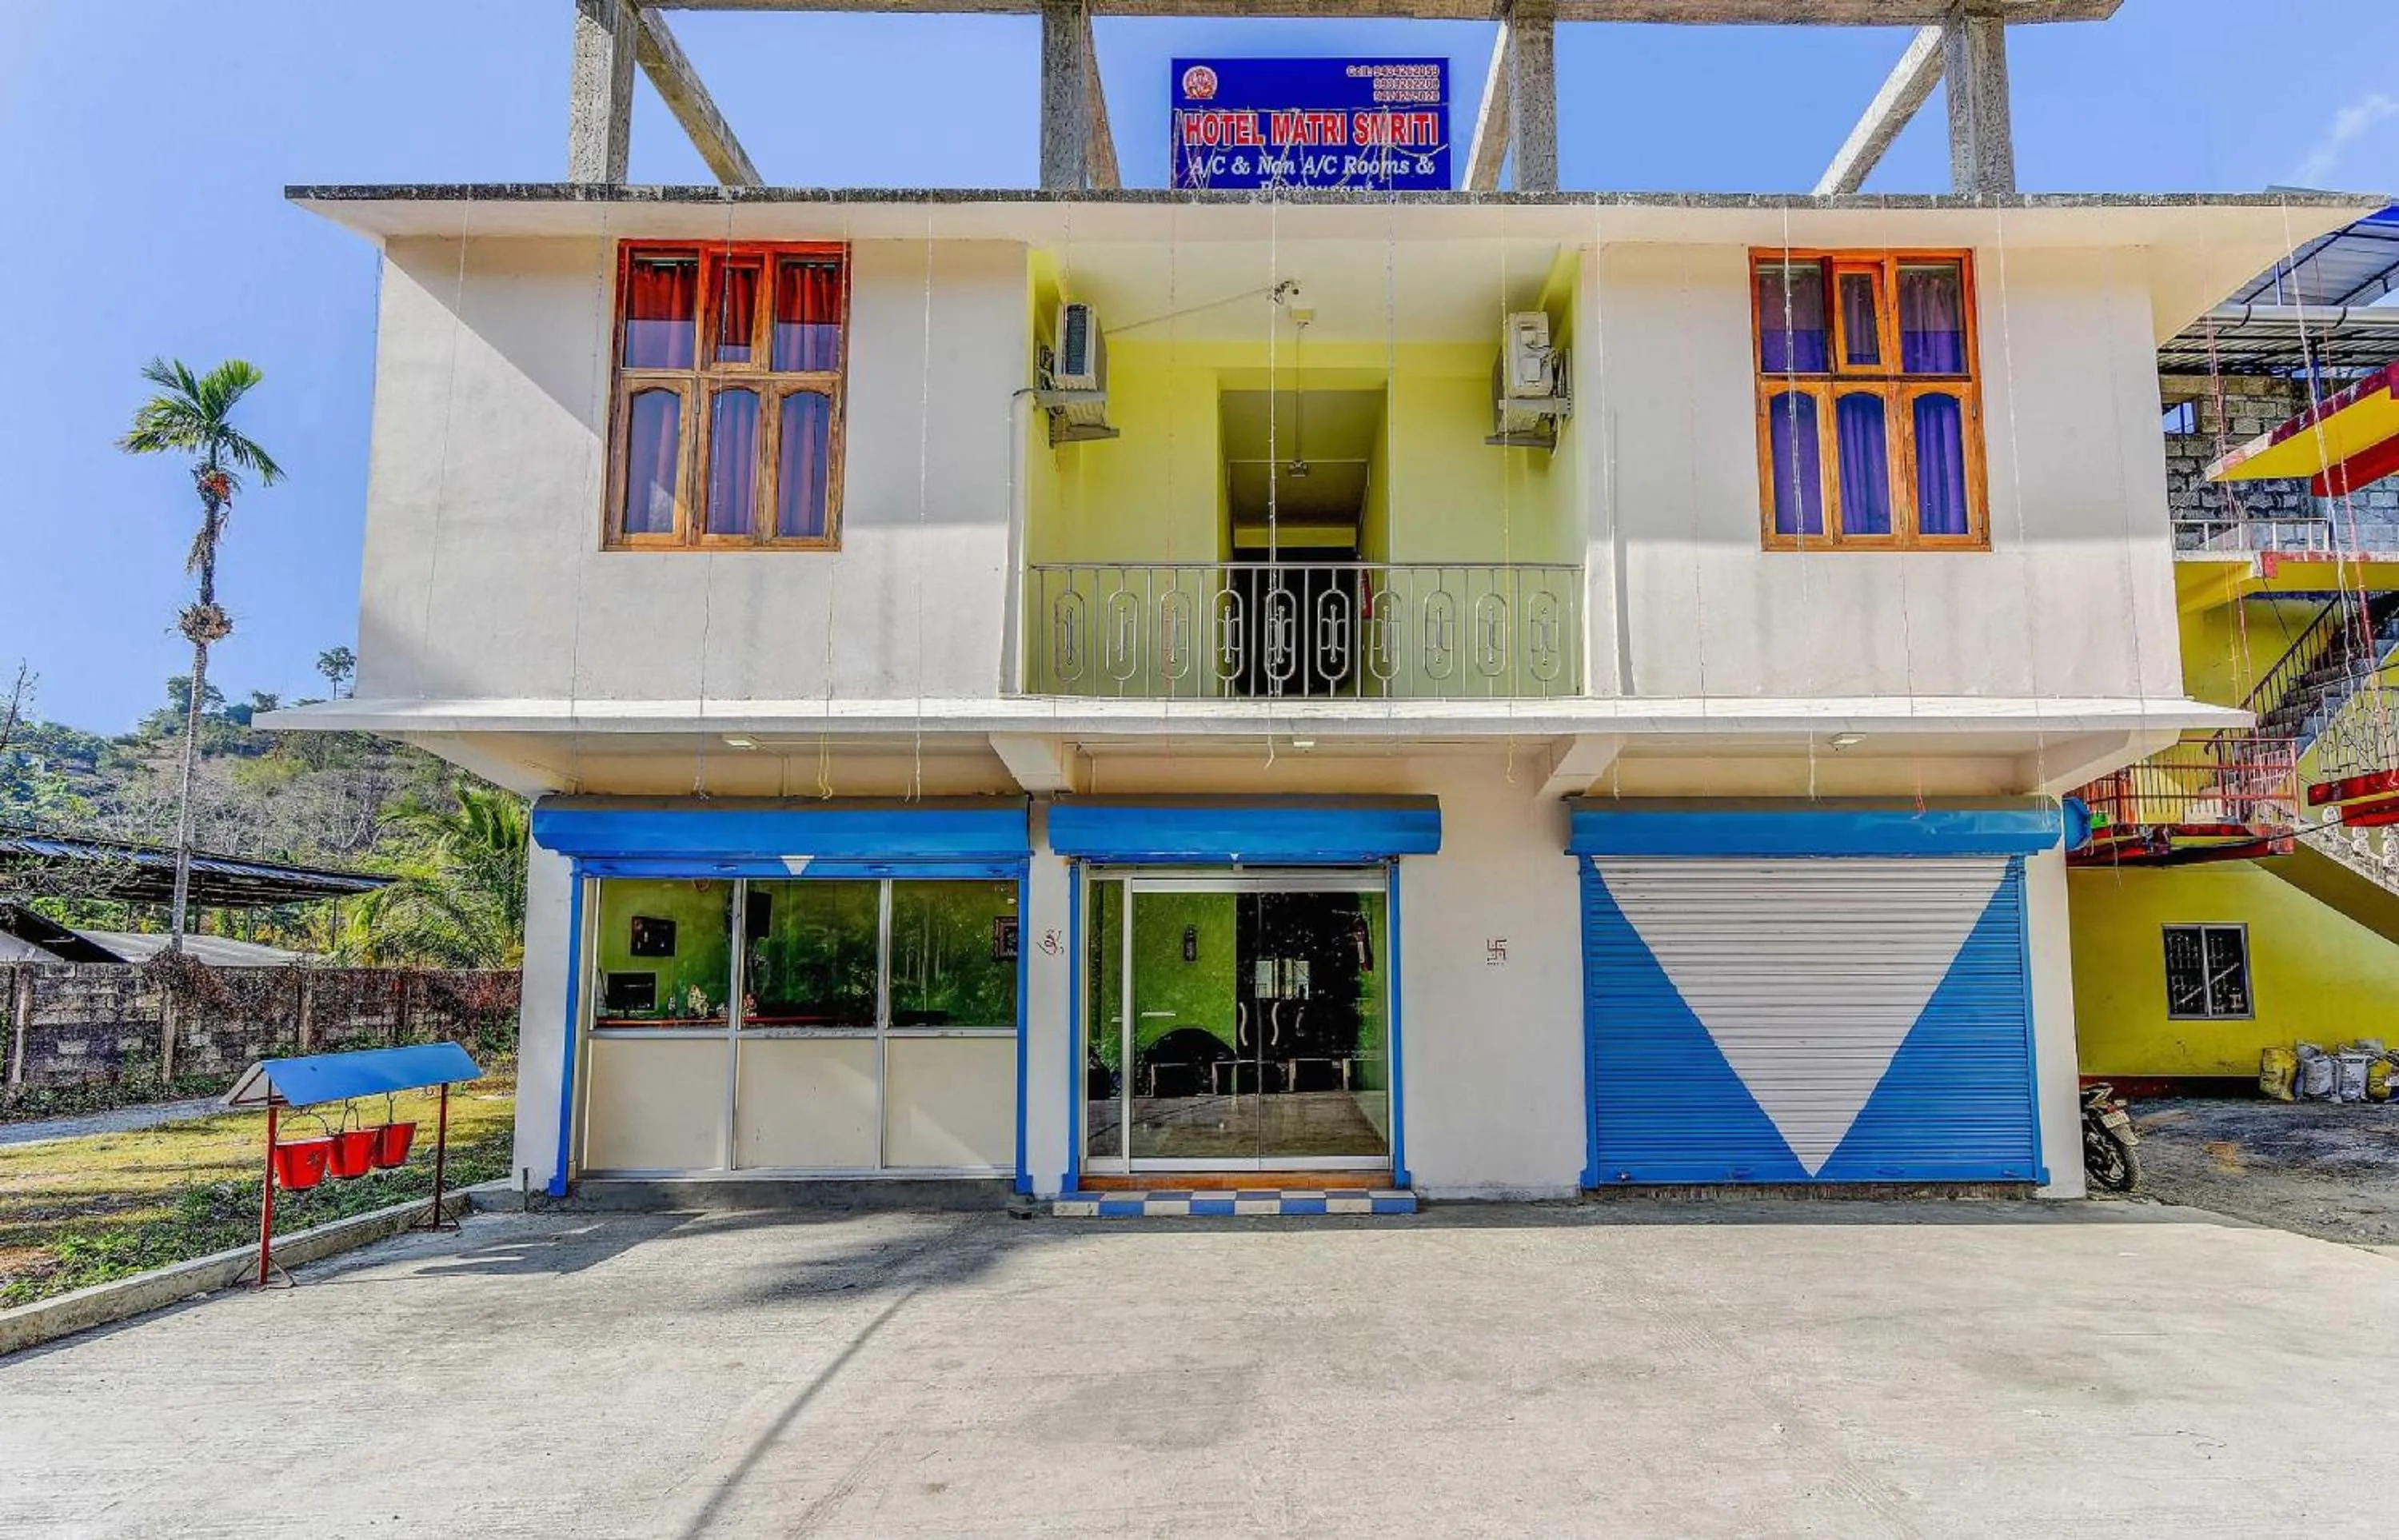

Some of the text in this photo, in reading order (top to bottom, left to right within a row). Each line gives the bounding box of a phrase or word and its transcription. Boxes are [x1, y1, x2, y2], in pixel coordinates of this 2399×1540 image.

[1184, 113, 1439, 146] HOTEL MATRI SMRITI
[1190, 155, 1435, 178] A/C & Non A/C Rooms &
